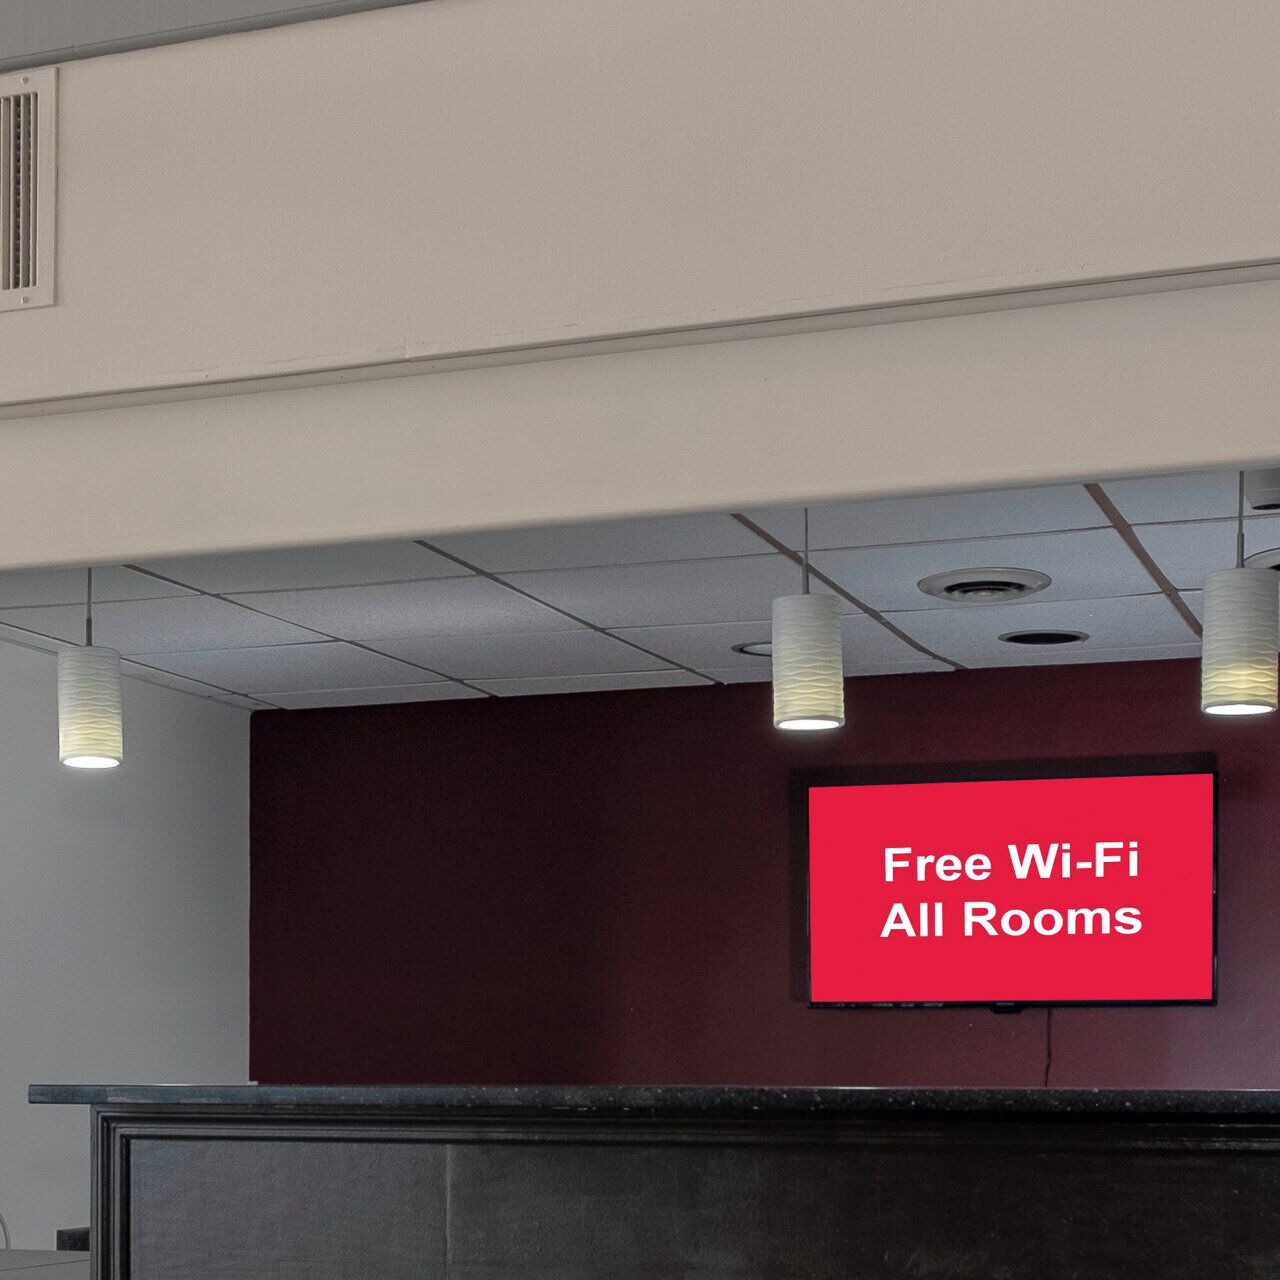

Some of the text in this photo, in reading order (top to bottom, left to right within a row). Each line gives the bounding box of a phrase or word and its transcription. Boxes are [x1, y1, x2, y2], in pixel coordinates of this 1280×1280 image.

[884, 841, 1139, 882] Free Wi-Fi
[880, 901, 1143, 938] All Rooms
